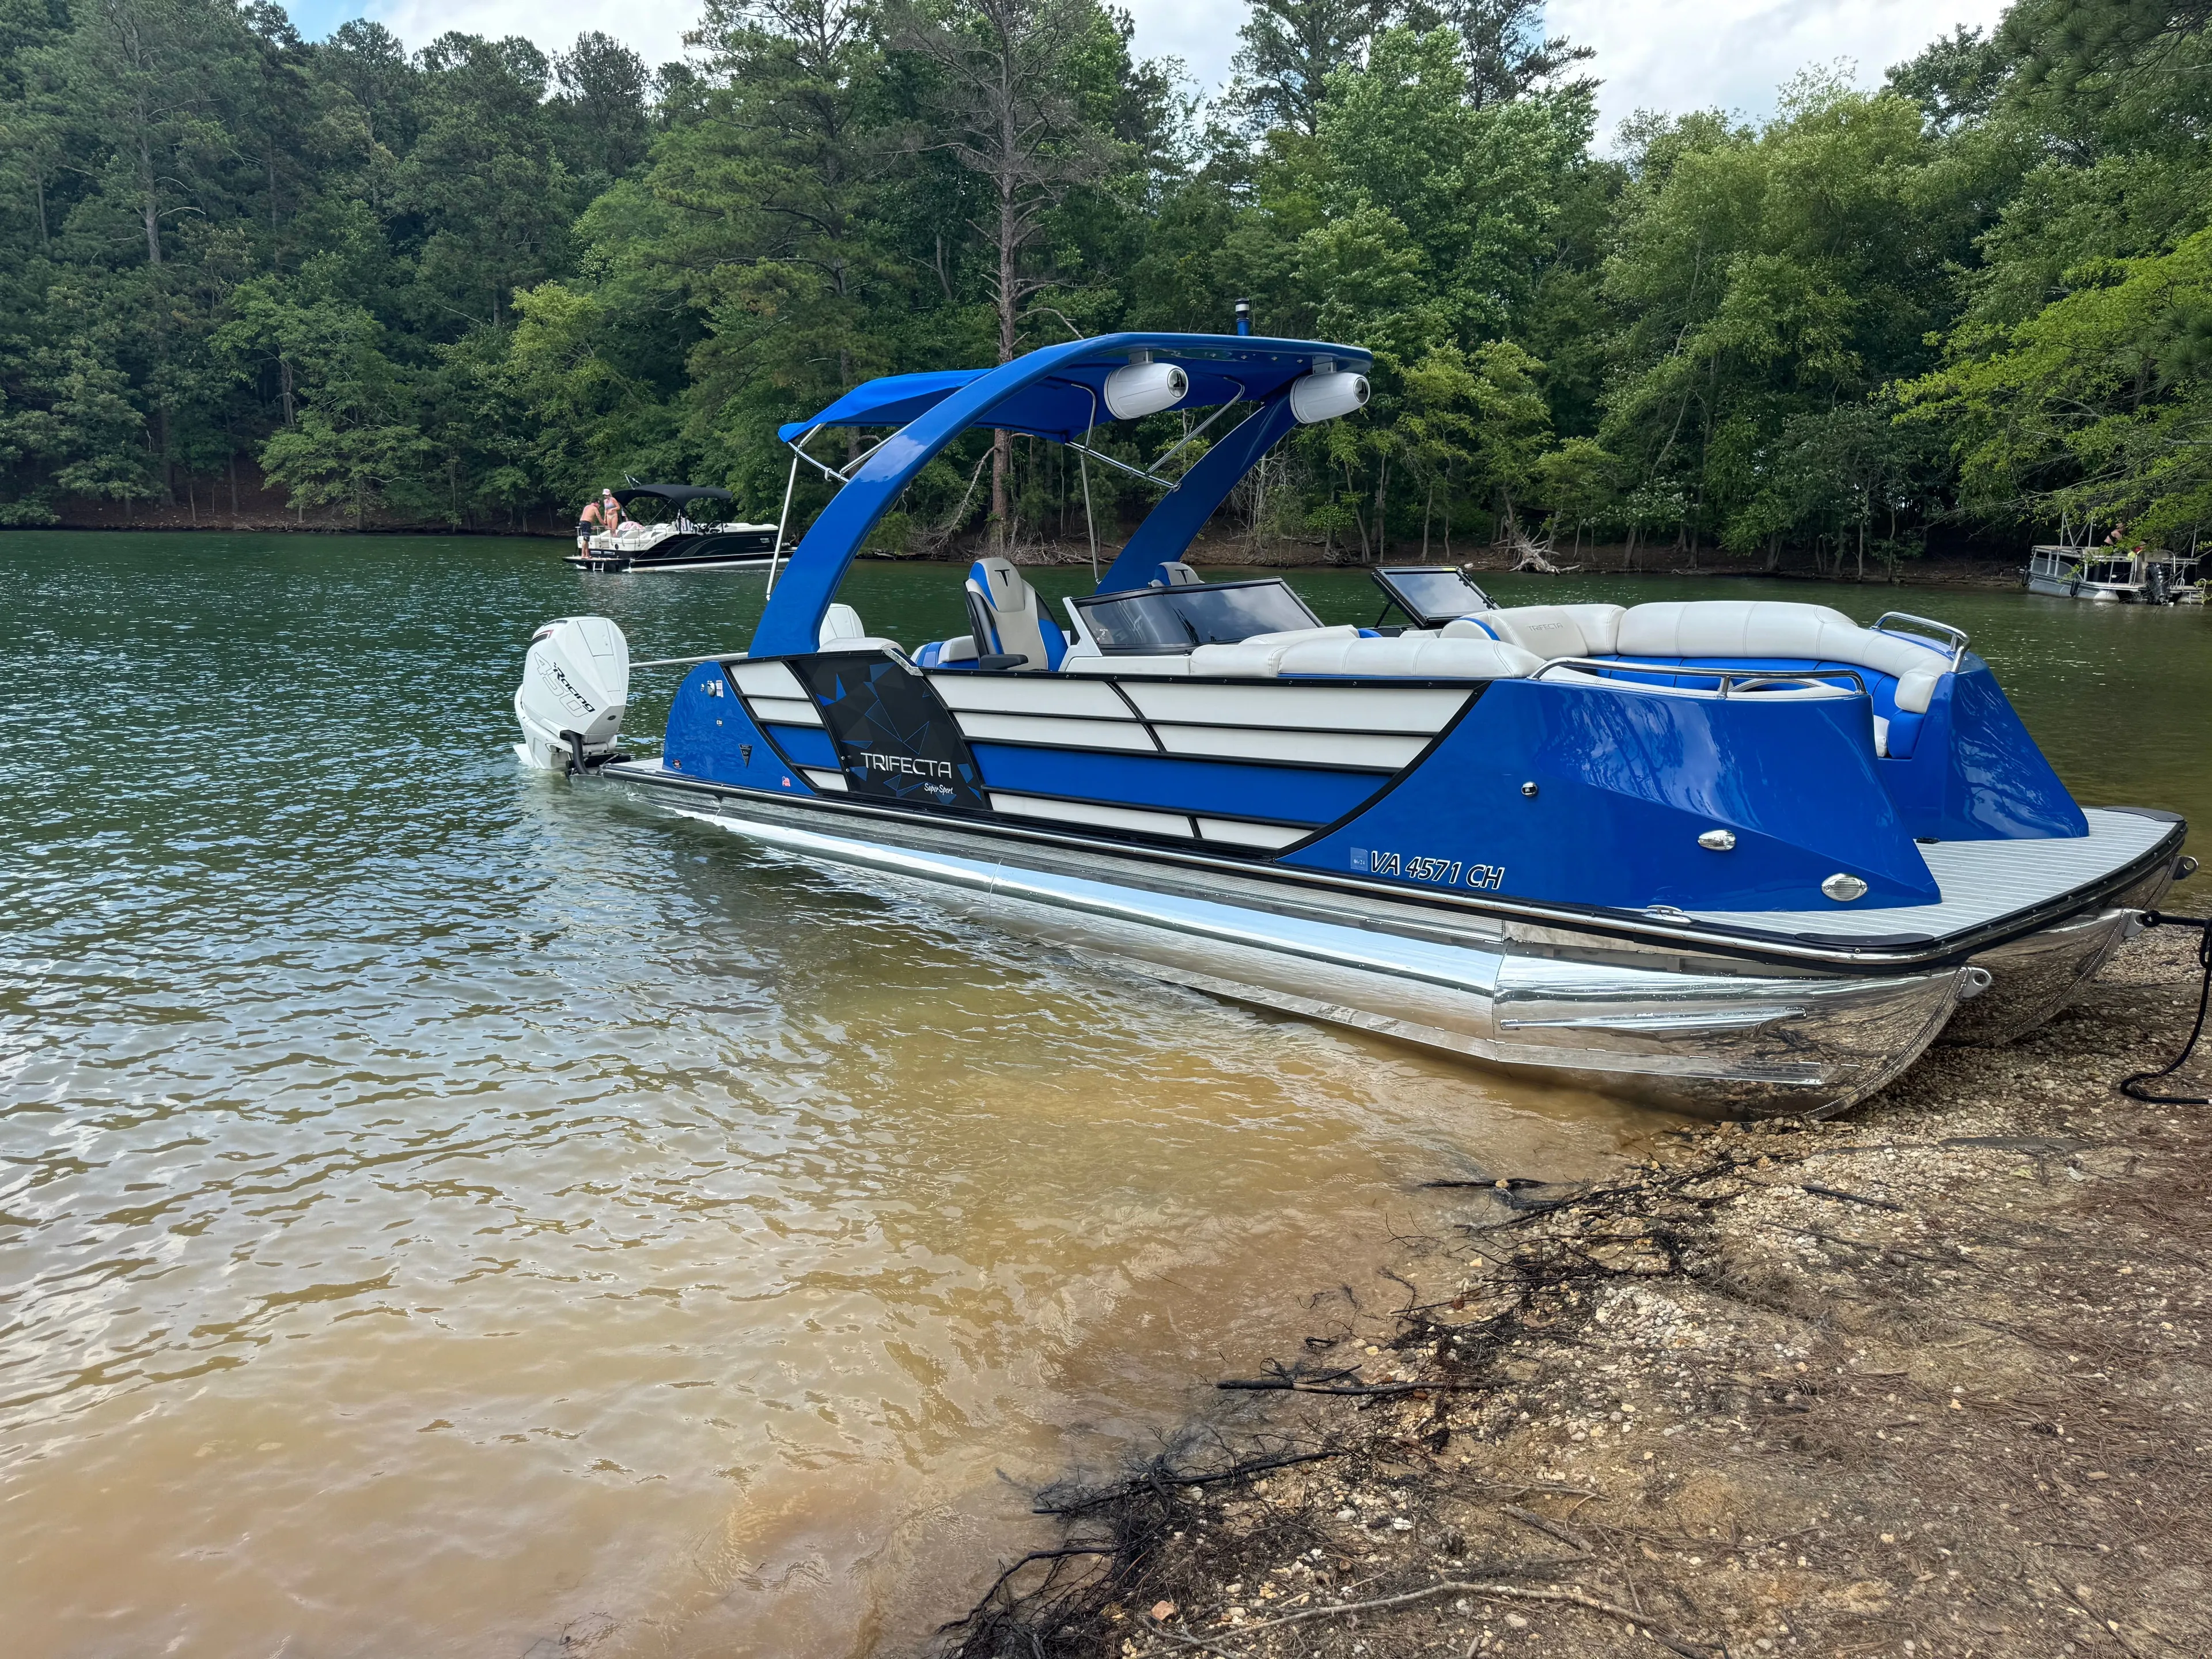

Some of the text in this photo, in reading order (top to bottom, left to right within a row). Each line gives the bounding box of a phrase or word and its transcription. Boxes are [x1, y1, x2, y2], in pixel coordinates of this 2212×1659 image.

[1527, 622, 1563, 631] TRIFECTA
[860, 752, 952, 779] TRIFECTA
[924, 782, 953, 796] Super Sport
[1371, 850, 1506, 889] VA 4571 CH
